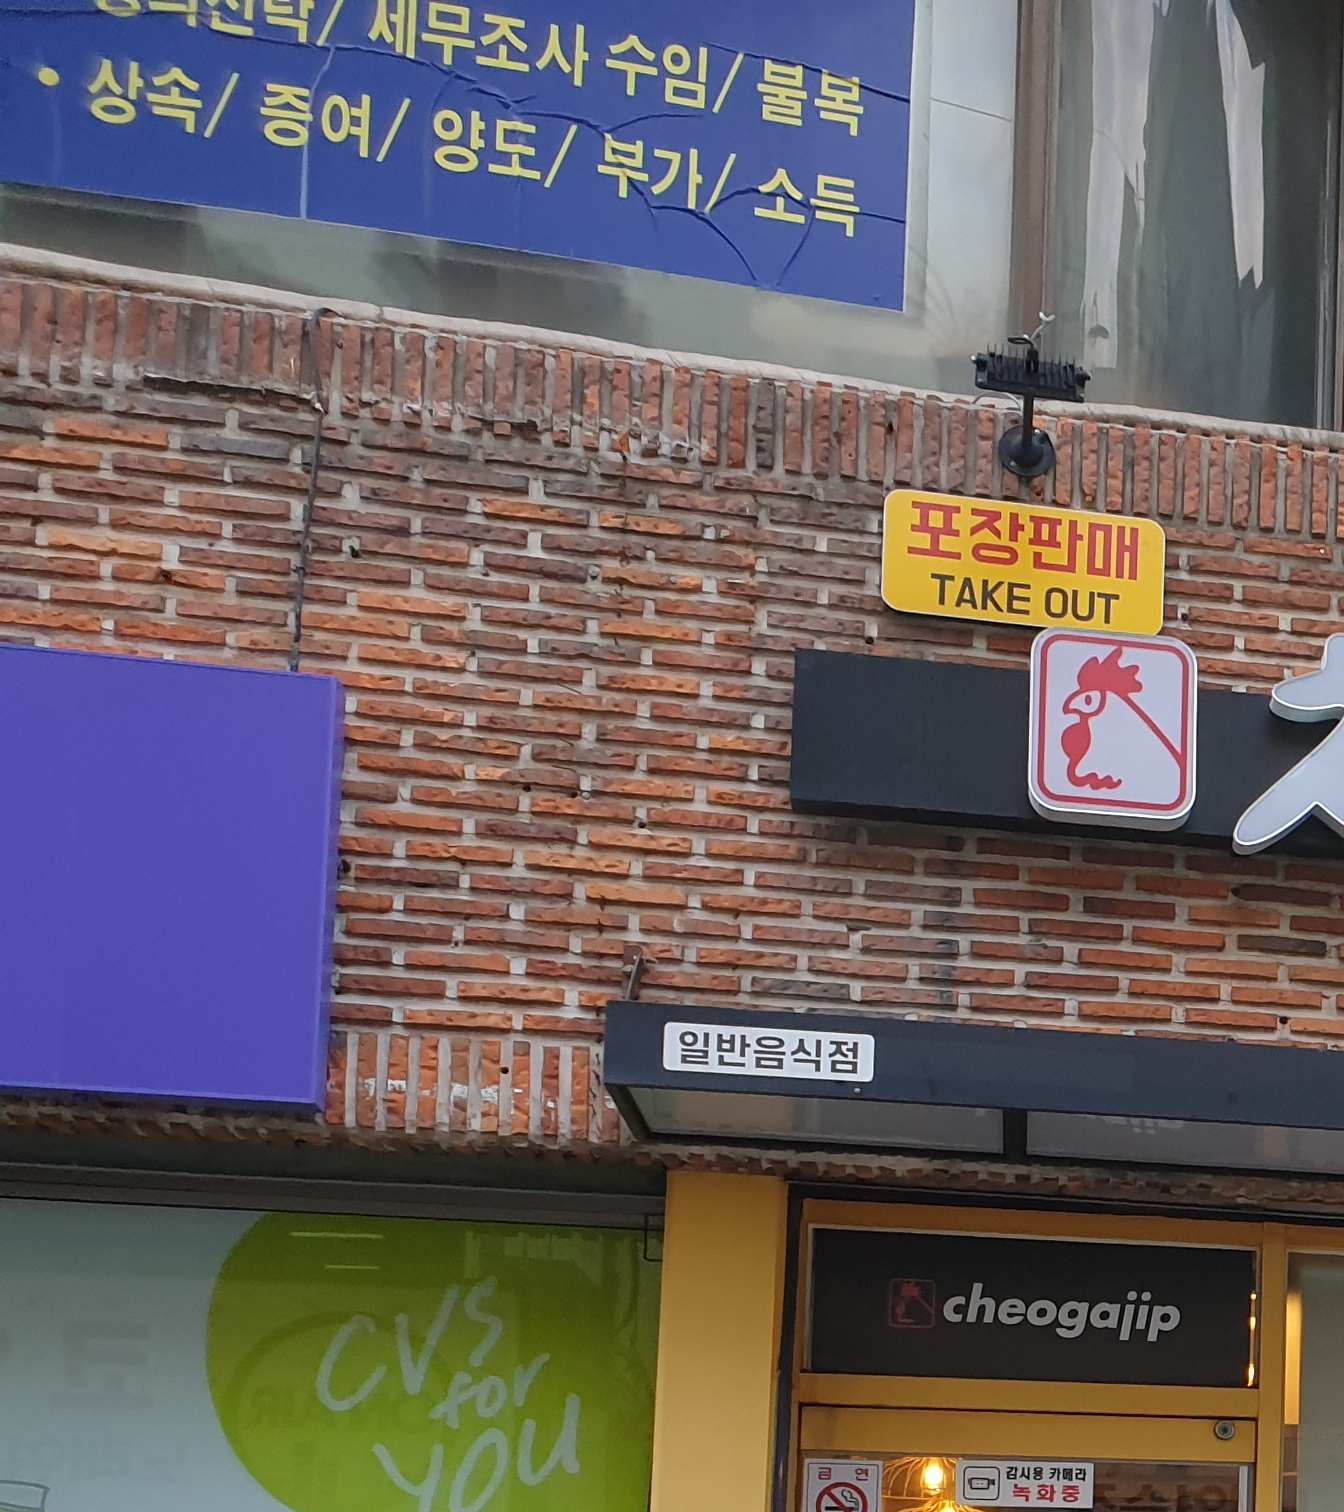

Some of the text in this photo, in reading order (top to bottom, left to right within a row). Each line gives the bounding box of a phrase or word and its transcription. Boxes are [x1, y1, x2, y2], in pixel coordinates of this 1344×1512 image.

[367, 1, 588, 86] 세무조사
[605, 35, 744, 112] 수임/
[88, 59, 239, 138] 상속/
[258, 82, 410, 162] 증여/
[432, 105, 578, 188] 양도/
[754, 168, 861, 237] 소득
[907, 501, 1139, 581] 포장판매
[931, 573, 1120, 624] TAKE OUT
[678, 1029, 860, 1075] 일반음식점
[316, 1276, 503, 1411] CVS
[942, 1282, 1181, 1343] cheogajip
[429, 1352, 550, 1428] for
[1006, 1466, 1087, 1482] 감시용 카메라
